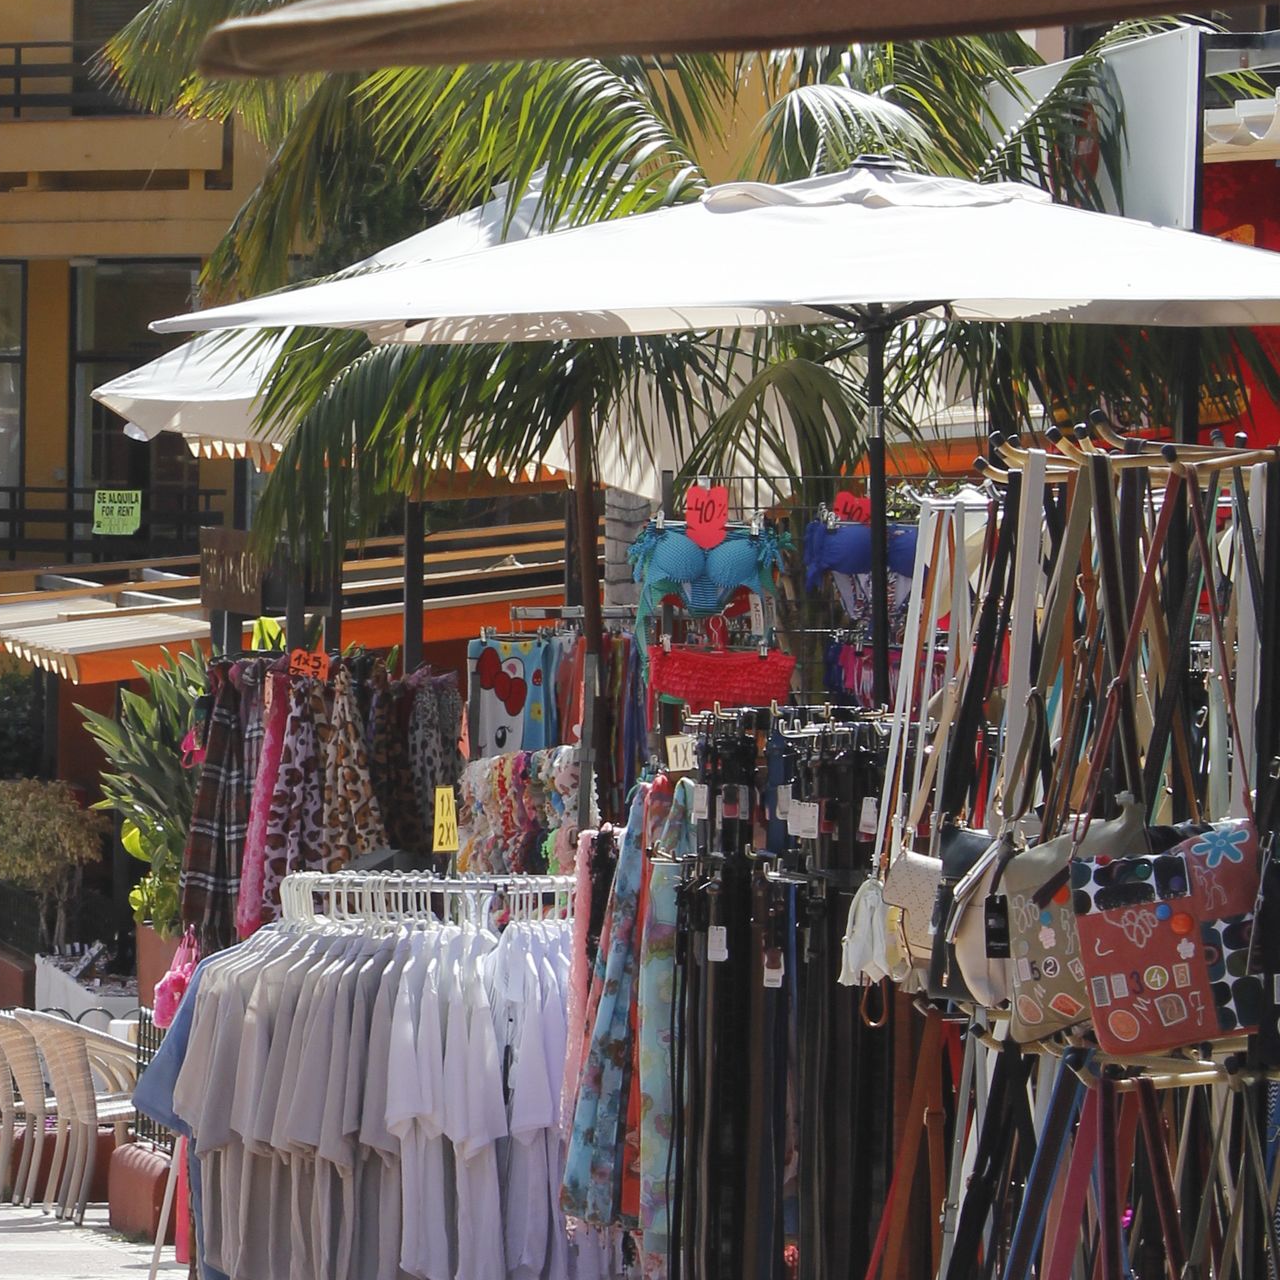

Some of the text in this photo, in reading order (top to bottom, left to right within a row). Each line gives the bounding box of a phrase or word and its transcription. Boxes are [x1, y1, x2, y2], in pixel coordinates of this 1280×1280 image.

[97, 492, 140, 505] SE ALQUILA
[101, 505, 135, 517] FOR RENT
[1045, 958, 1056, 976] 2
[1149, 968, 1163, 987] 4
